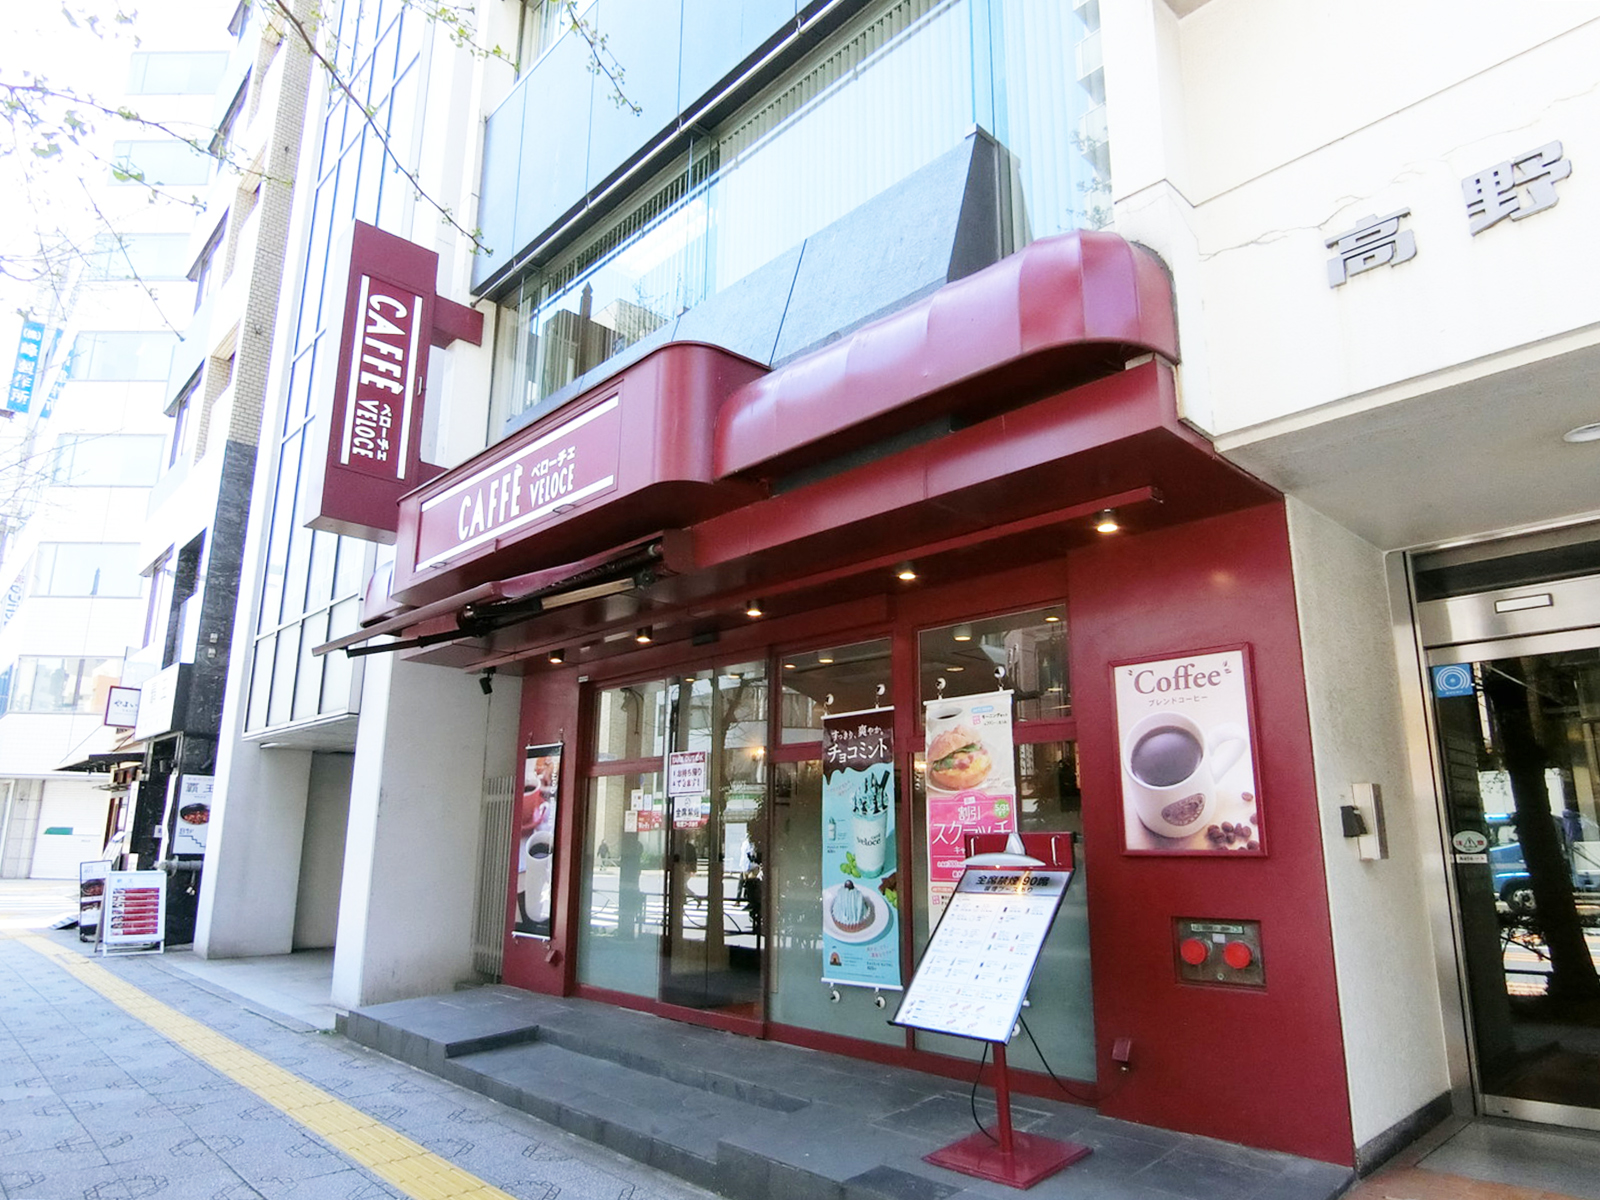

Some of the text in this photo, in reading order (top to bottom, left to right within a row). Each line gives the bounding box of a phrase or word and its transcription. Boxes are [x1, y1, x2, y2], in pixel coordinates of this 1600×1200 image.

[352, 399, 380, 459] VELOCE
[376, 403, 393, 462] ベローチェ
[530, 445, 576, 478] ベローチェ
[529, 463, 575, 508] VELOCE
[1148, 695, 1209, 707] ブレンドコーヒー
[827, 738, 888, 763] チョコミント
[975, 874, 1020, 886] 全席禁煙
